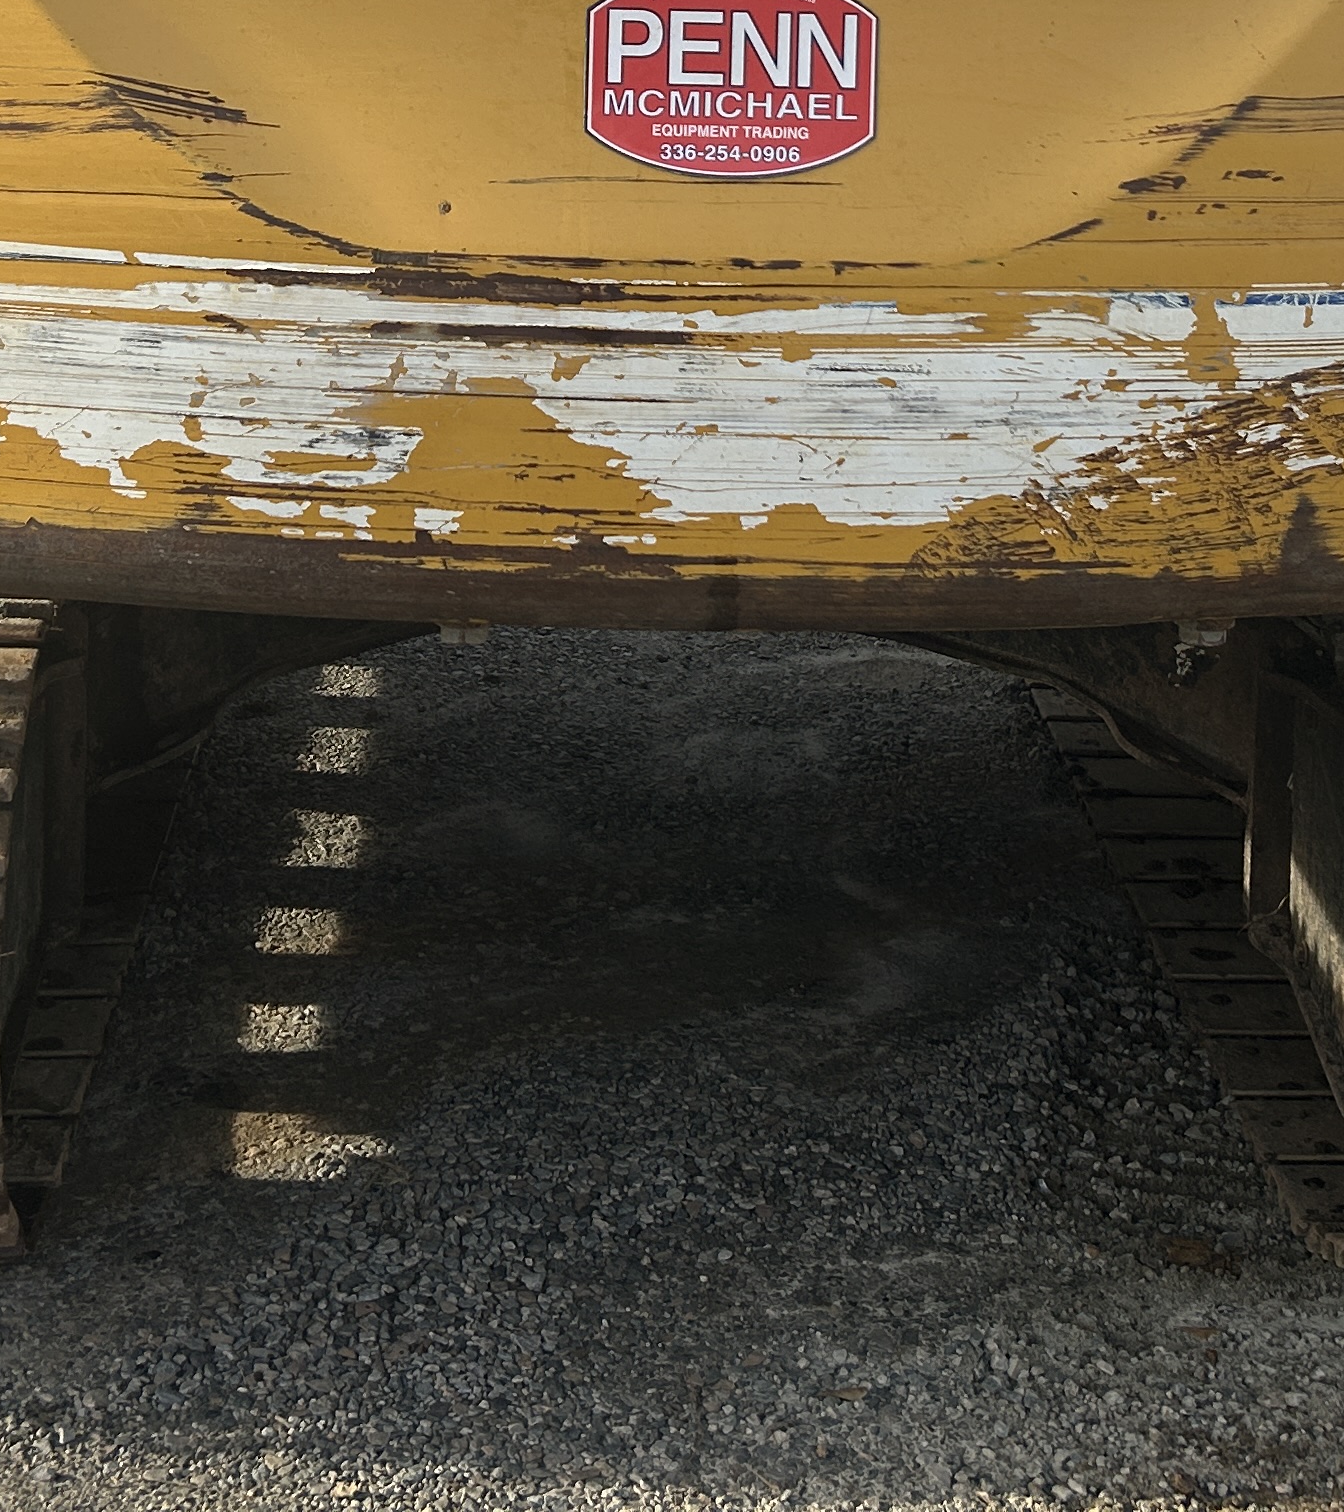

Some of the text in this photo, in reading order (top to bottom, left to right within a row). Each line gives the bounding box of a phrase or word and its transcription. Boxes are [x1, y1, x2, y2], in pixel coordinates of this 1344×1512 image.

[607, 8, 858, 89] PENN
[603, 89, 858, 120] MCMICHAEL
[651, 123, 809, 140] EQUIPMENT TRADING
[660, 143, 801, 163] 336-254-0906
